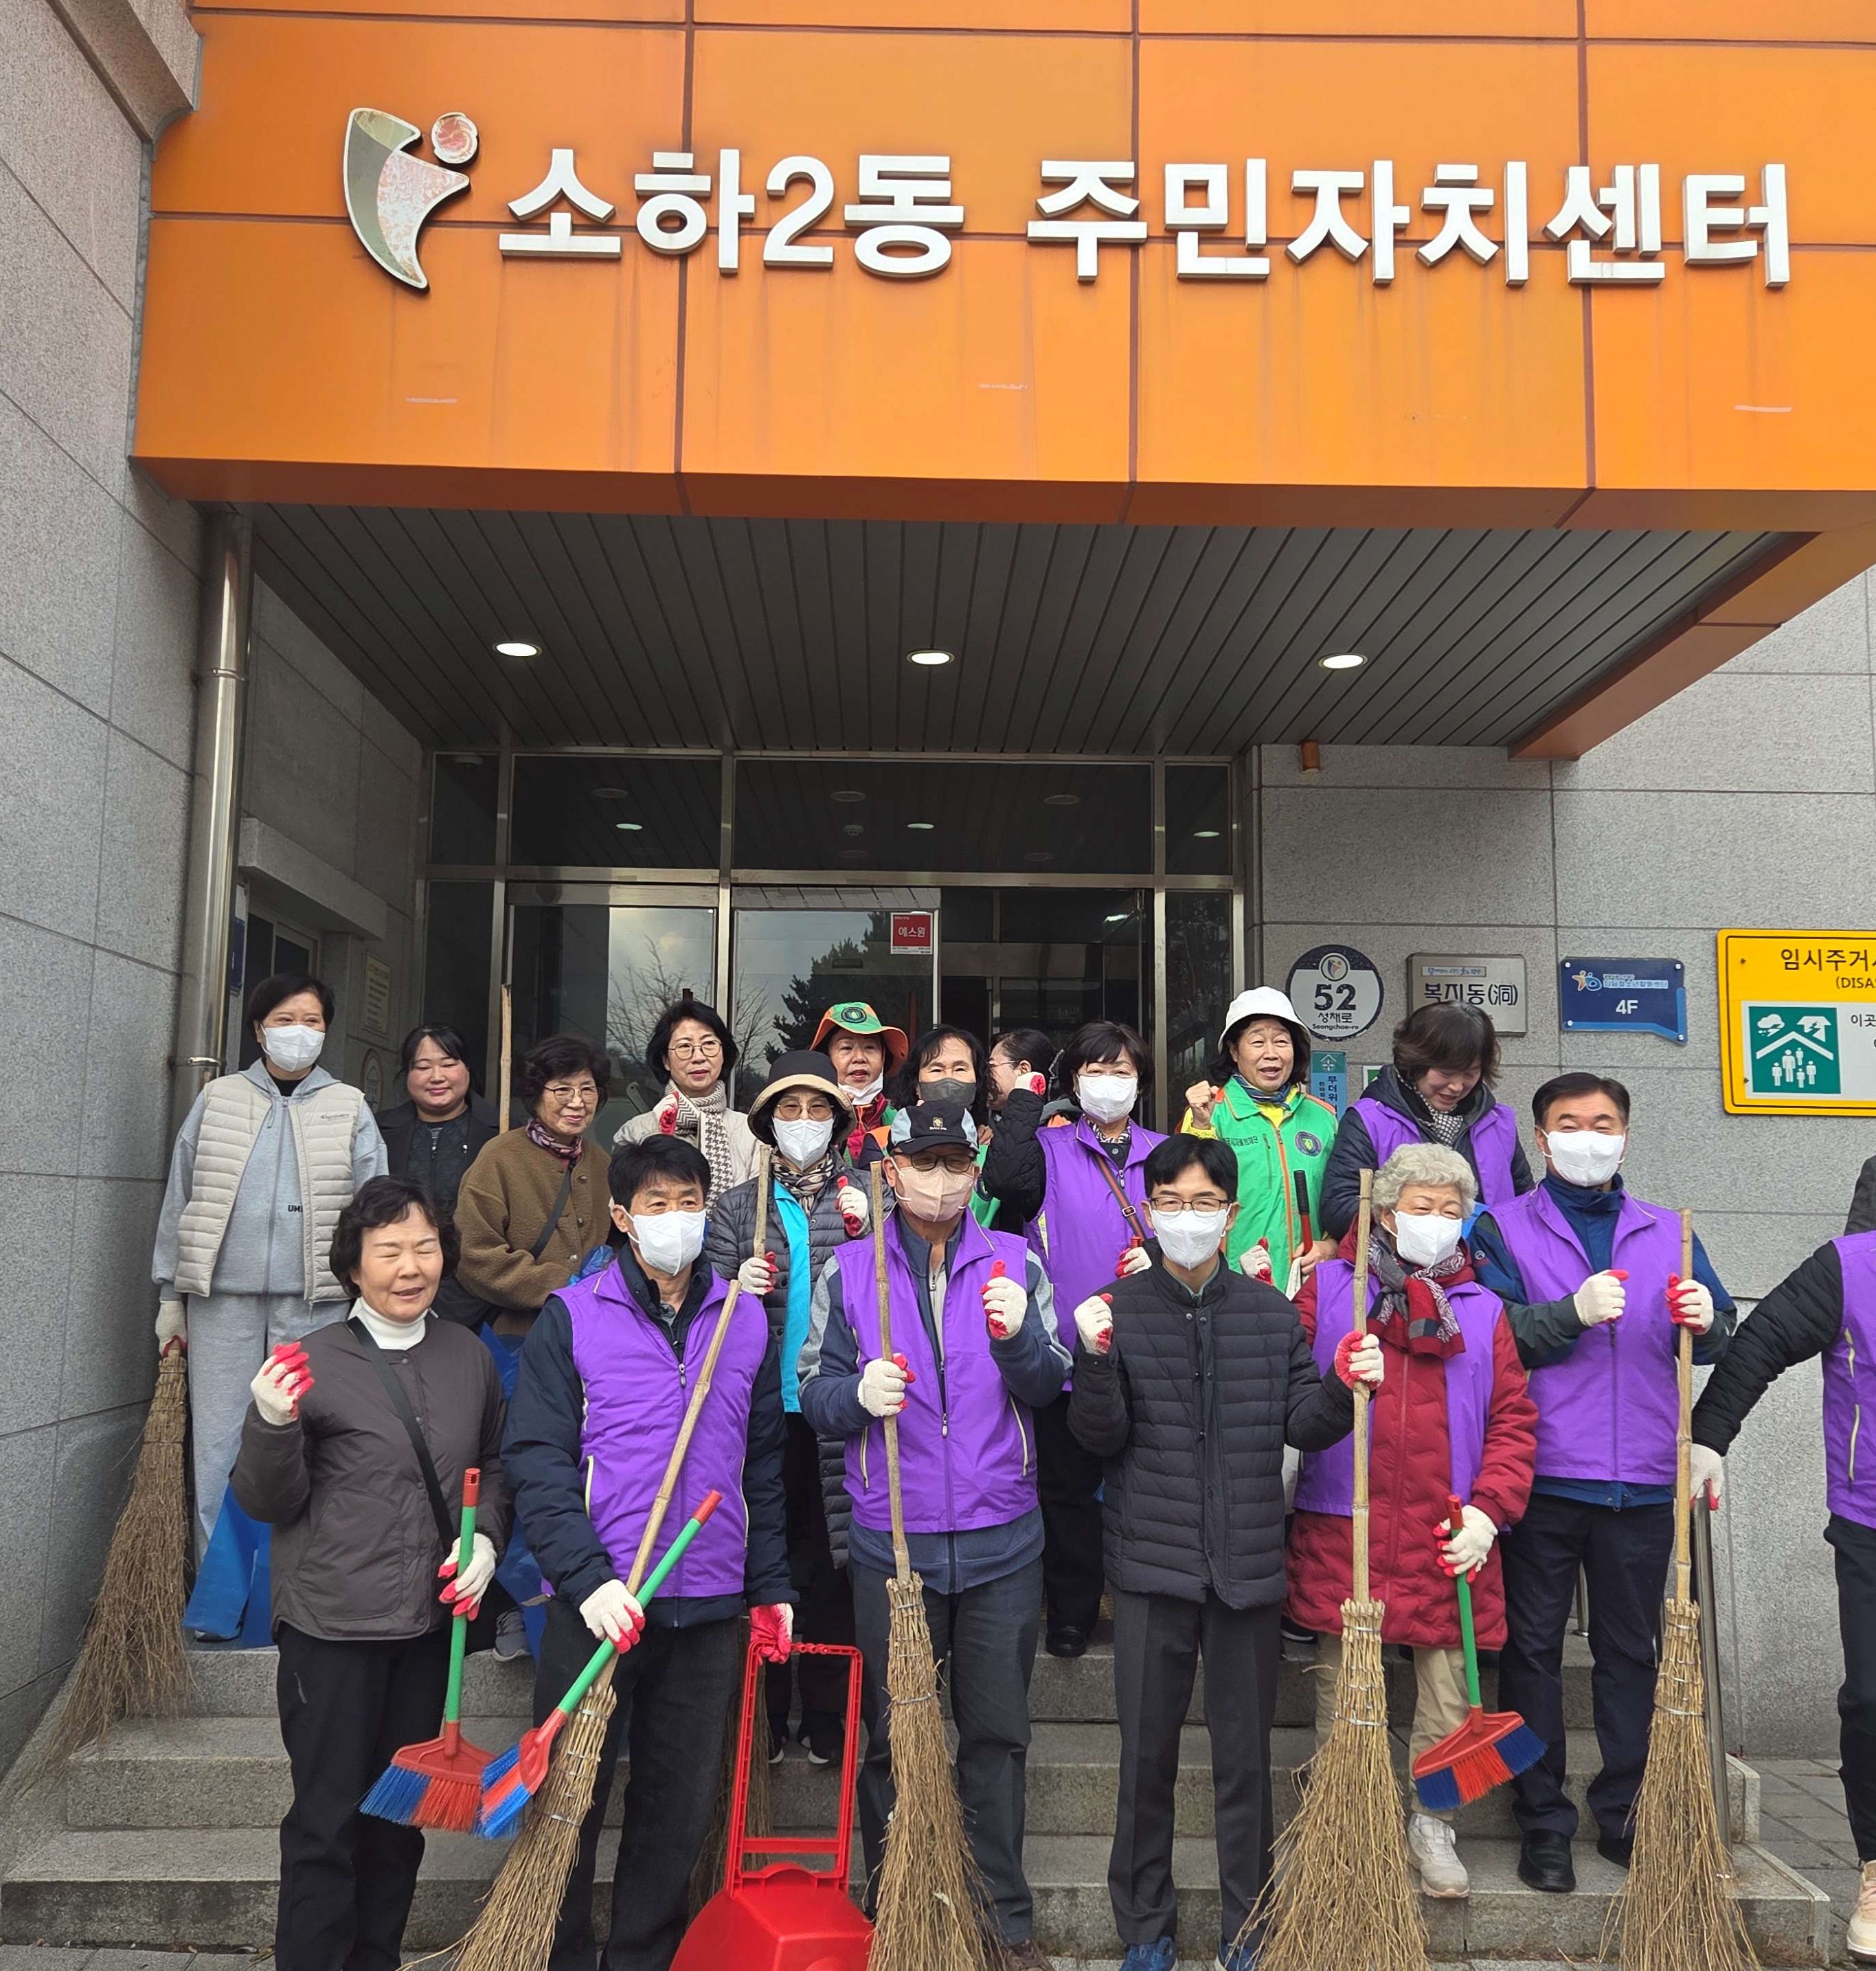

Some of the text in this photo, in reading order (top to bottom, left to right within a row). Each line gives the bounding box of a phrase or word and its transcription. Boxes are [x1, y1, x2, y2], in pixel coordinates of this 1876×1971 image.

[499, 148, 1791, 287] 소하2동 주민자치센터
[899, 926, 926, 938] 에스원
[1781, 948, 1876, 972] 임시주거
[1424, 982, 1519, 1006] 복지동(洞)
[1835, 976, 1876, 989] (DISA
[1314, 983, 1357, 1011] 52
[1616, 999, 1639, 1015] 4F
[1318, 1012, 1353, 1024] 성채로
[1327, 1075, 1337, 1112] 무더위
